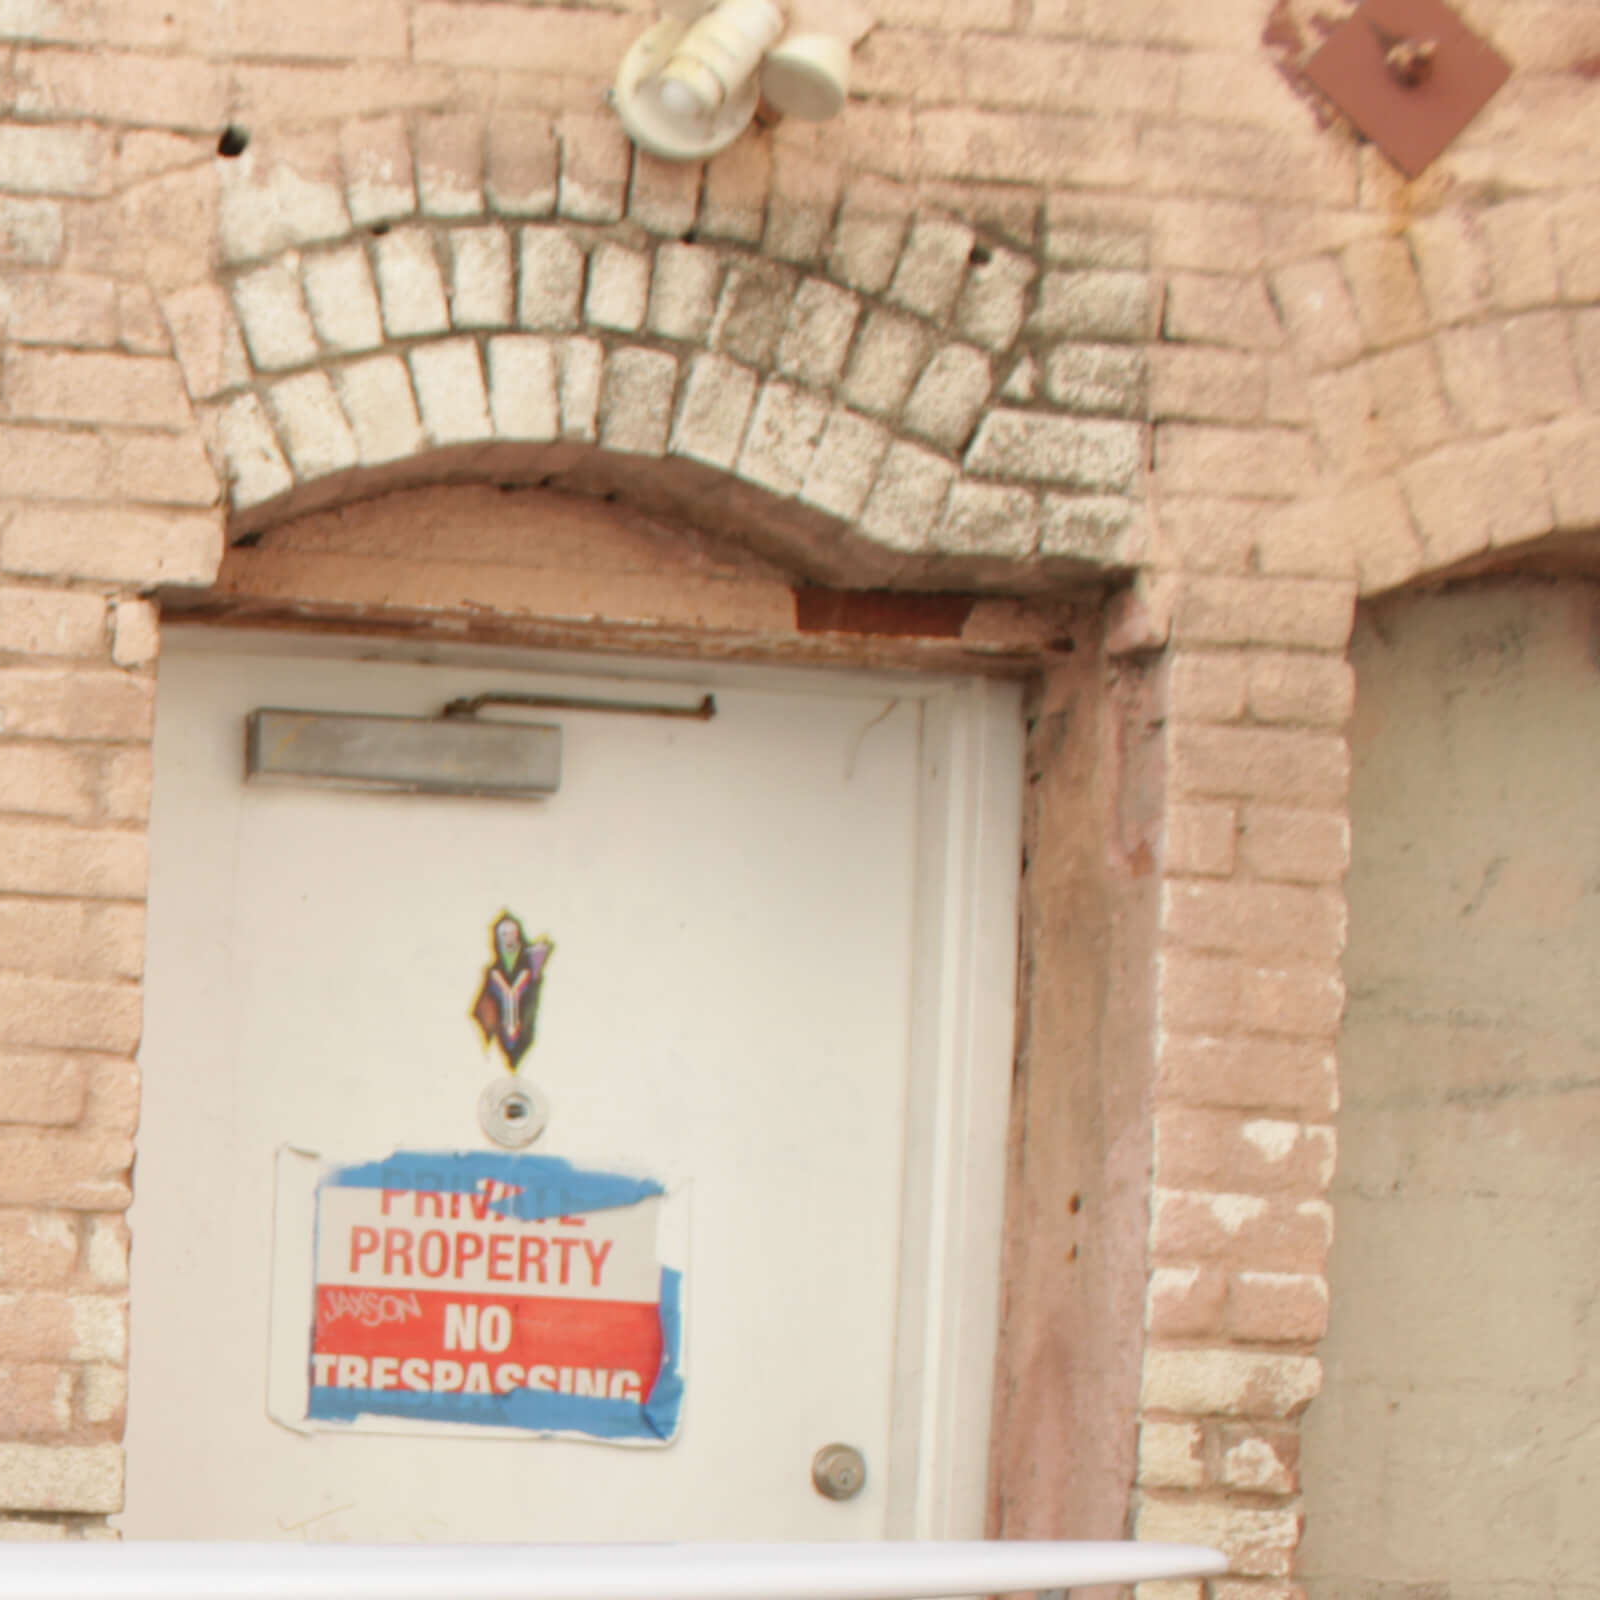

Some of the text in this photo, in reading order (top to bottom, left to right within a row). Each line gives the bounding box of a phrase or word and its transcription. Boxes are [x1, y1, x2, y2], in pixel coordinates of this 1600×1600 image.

[378, 1167, 585, 1225] PRIV
[349, 1225, 614, 1287] PROPERTY
[443, 1303, 512, 1353] NO
